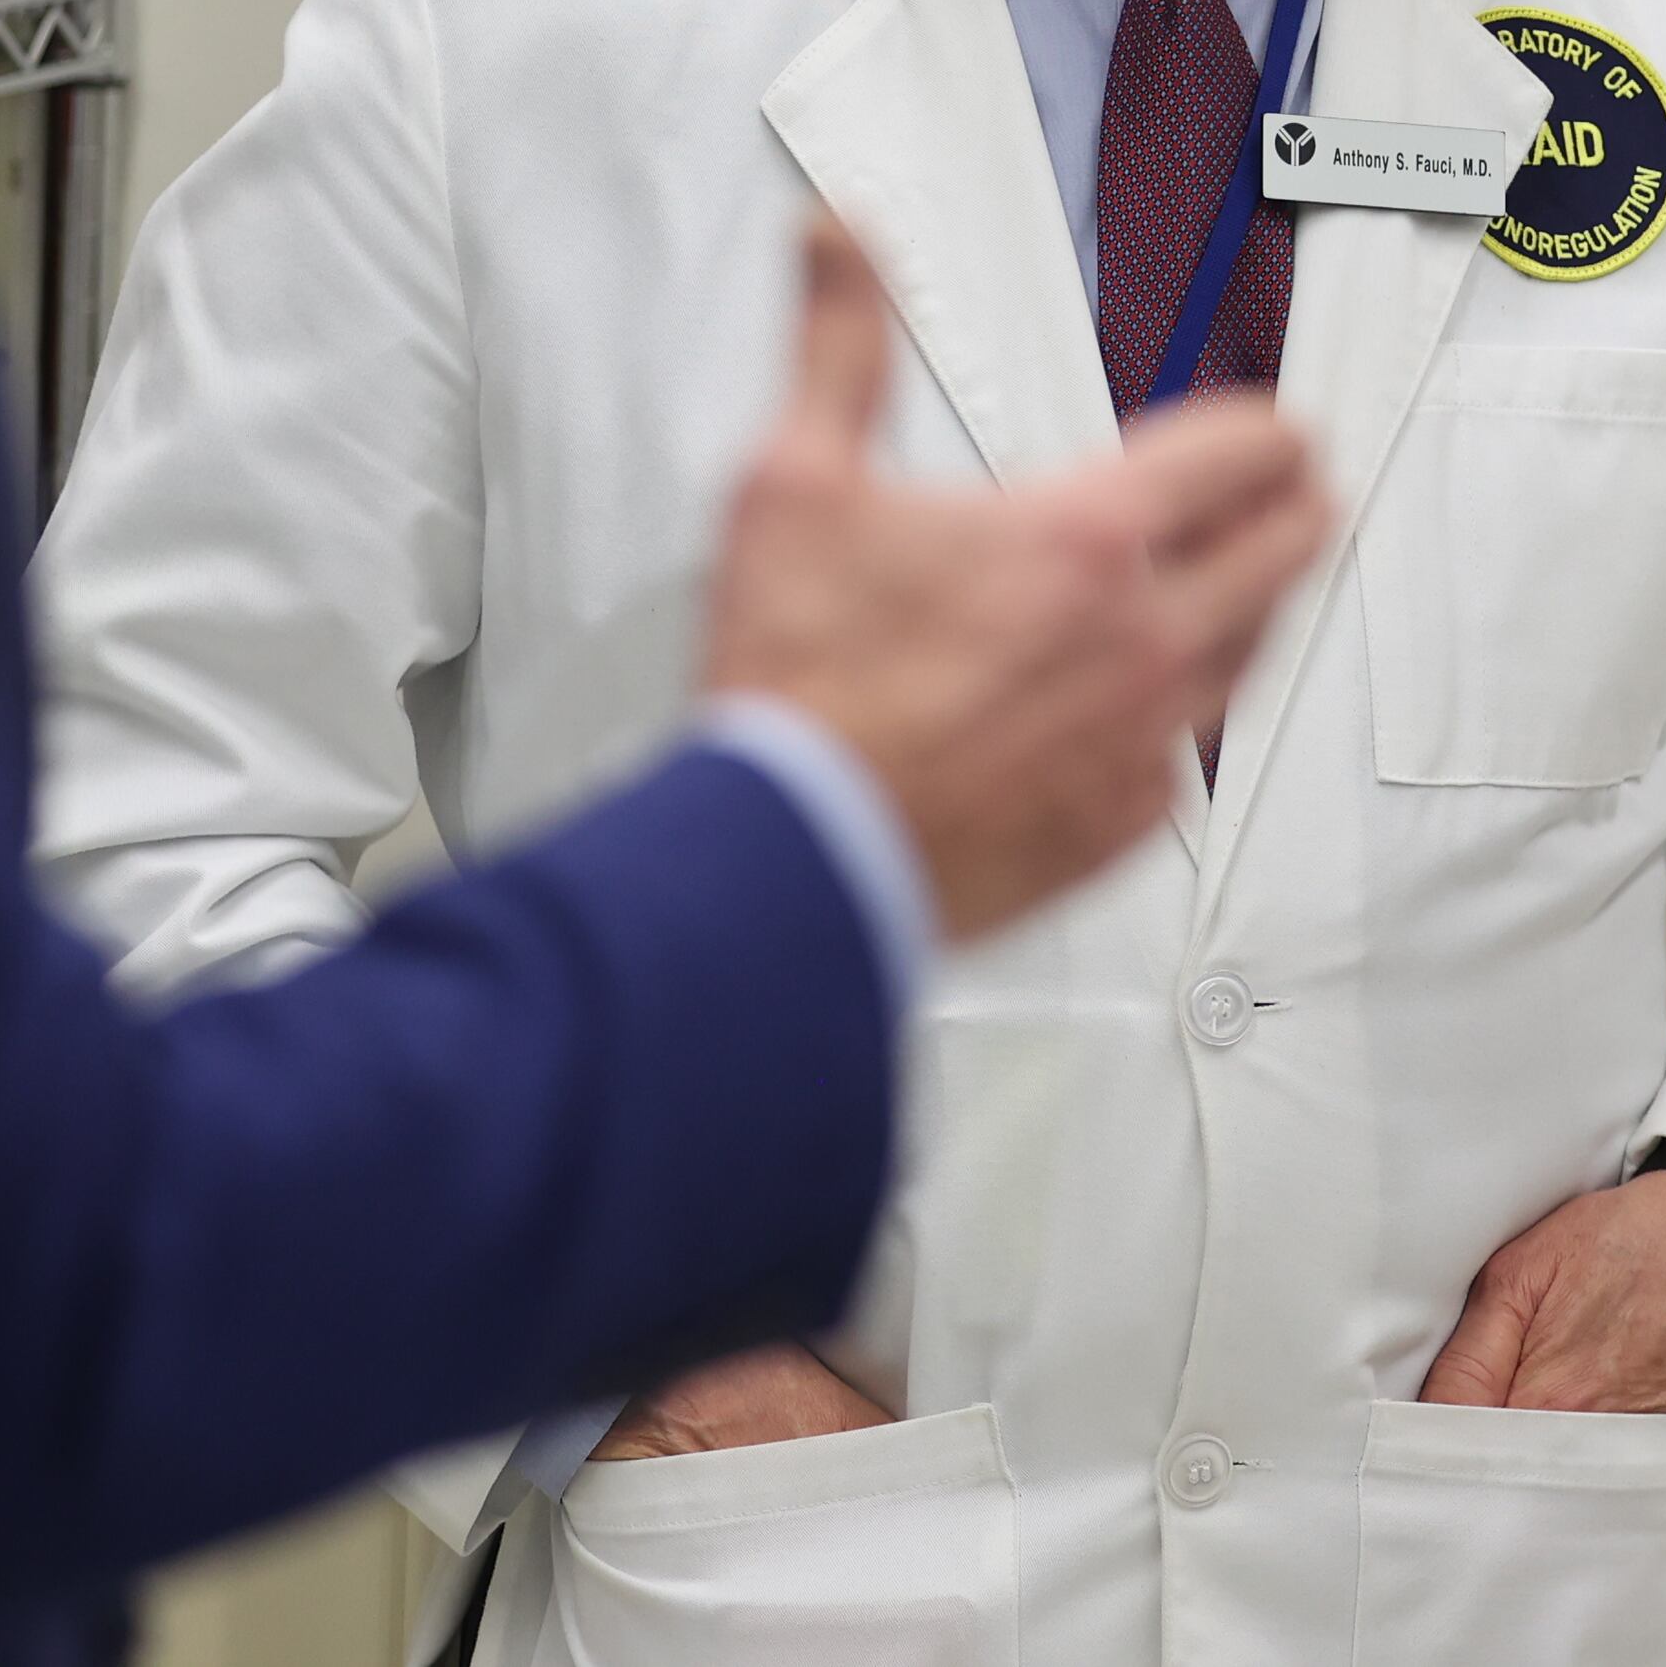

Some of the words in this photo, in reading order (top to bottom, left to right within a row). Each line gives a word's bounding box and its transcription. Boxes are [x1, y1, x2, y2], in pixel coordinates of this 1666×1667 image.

[1603, 65, 1644, 100] OF
[1523, 120, 1605, 167] AID
[1333, 147, 1389, 174] Anthony
[1396, 152, 1409, 171] S.
[1416, 154, 1456, 178] Fauci,
[1463, 157, 1492, 177] M.D.
